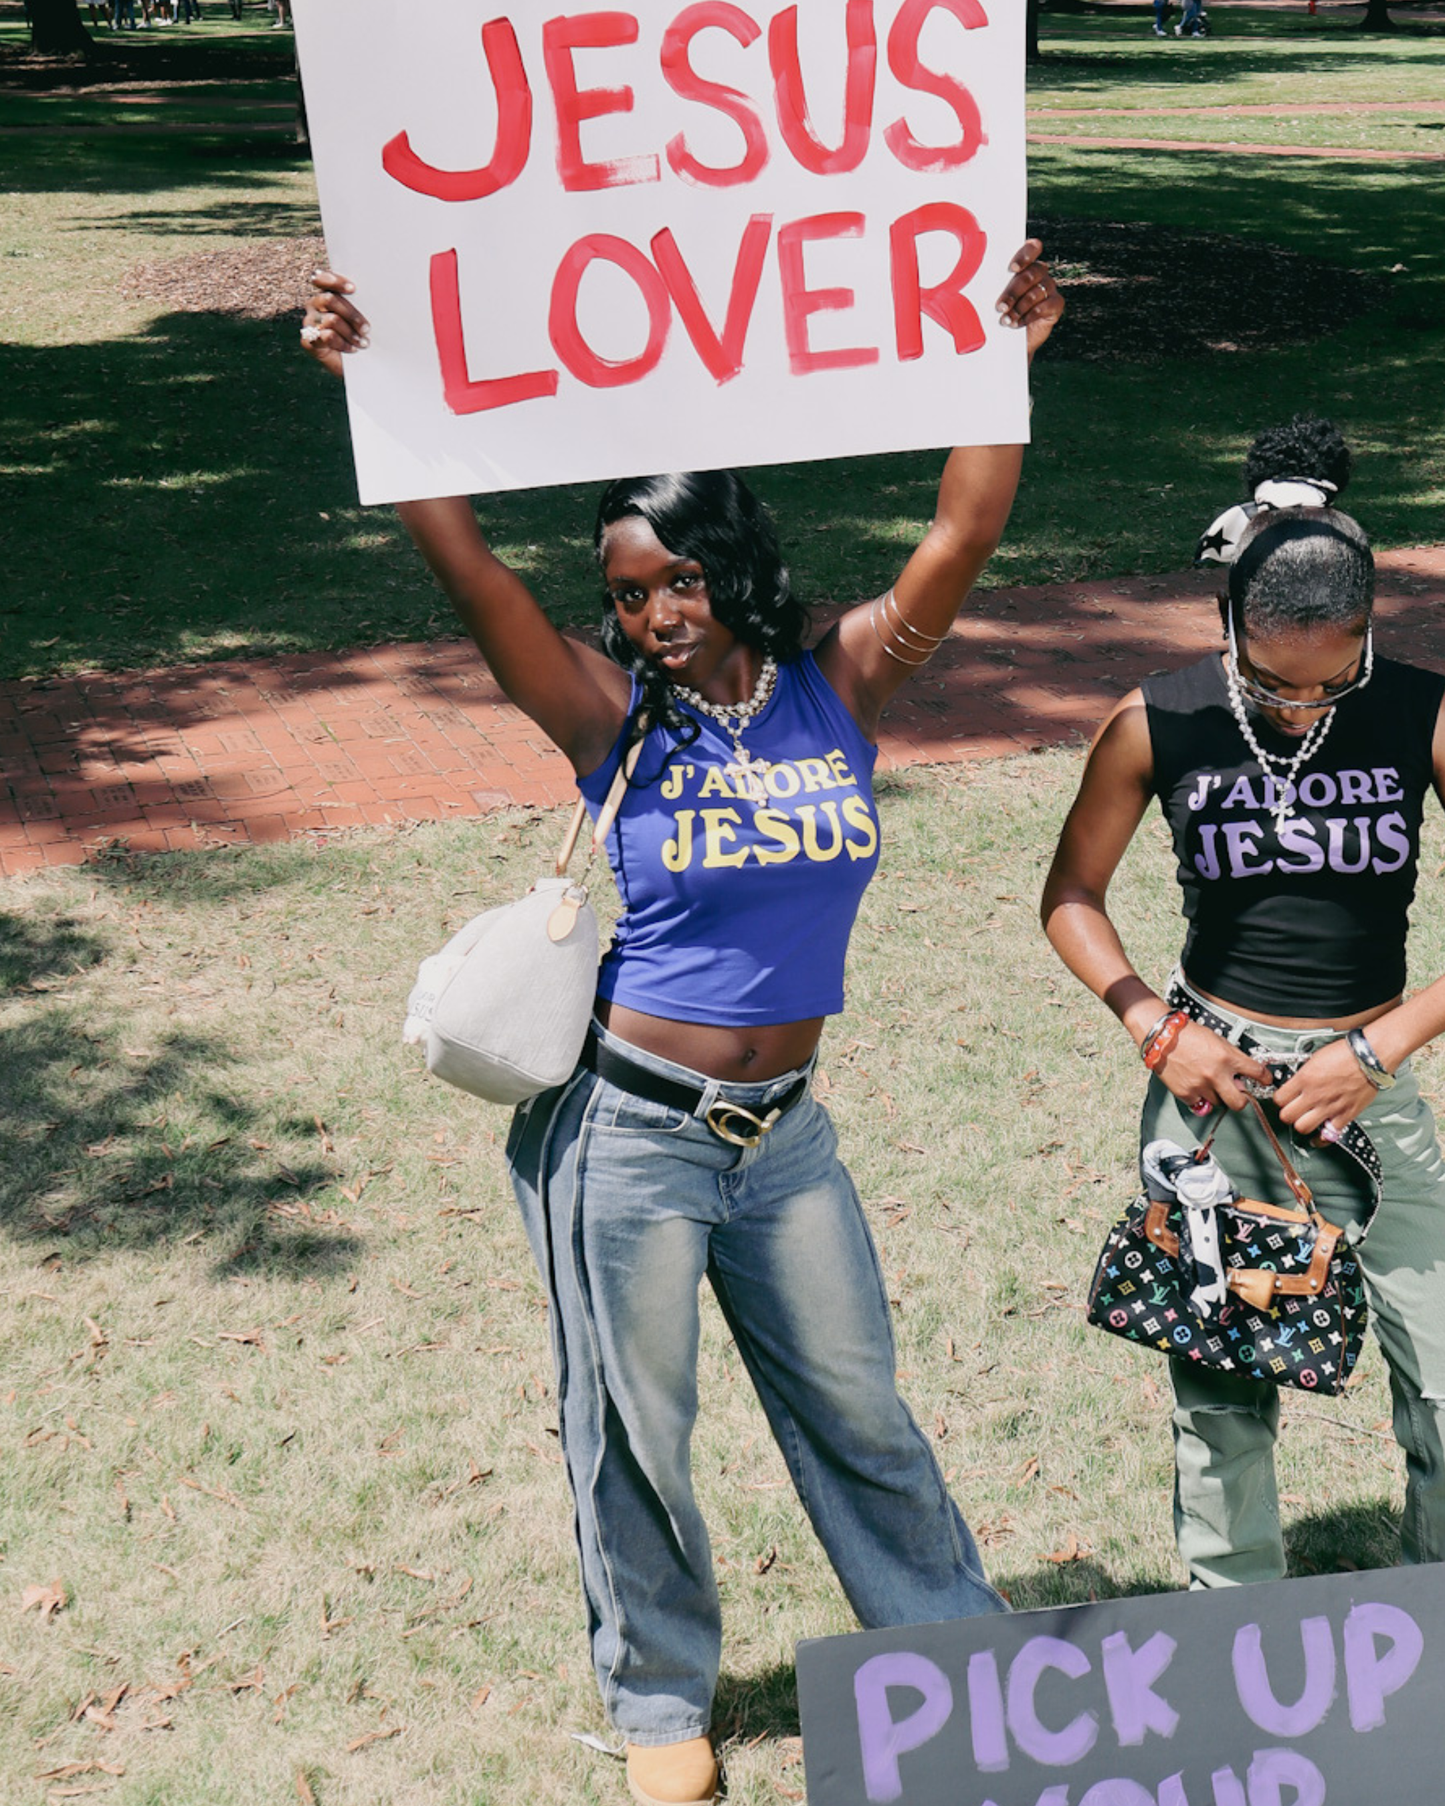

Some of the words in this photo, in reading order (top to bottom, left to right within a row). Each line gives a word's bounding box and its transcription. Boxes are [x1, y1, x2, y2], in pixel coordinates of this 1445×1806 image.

[382, 0, 989, 202] JESUS
[429, 201, 988, 415] LOVER
[661, 795, 878, 873] JESUS
[1188, 767, 1404, 811] J'ADORE
[1194, 811, 1411, 880] JESUS
[854, 1630, 1181, 1802] PICK
[1231, 1600, 1425, 1738] UP
